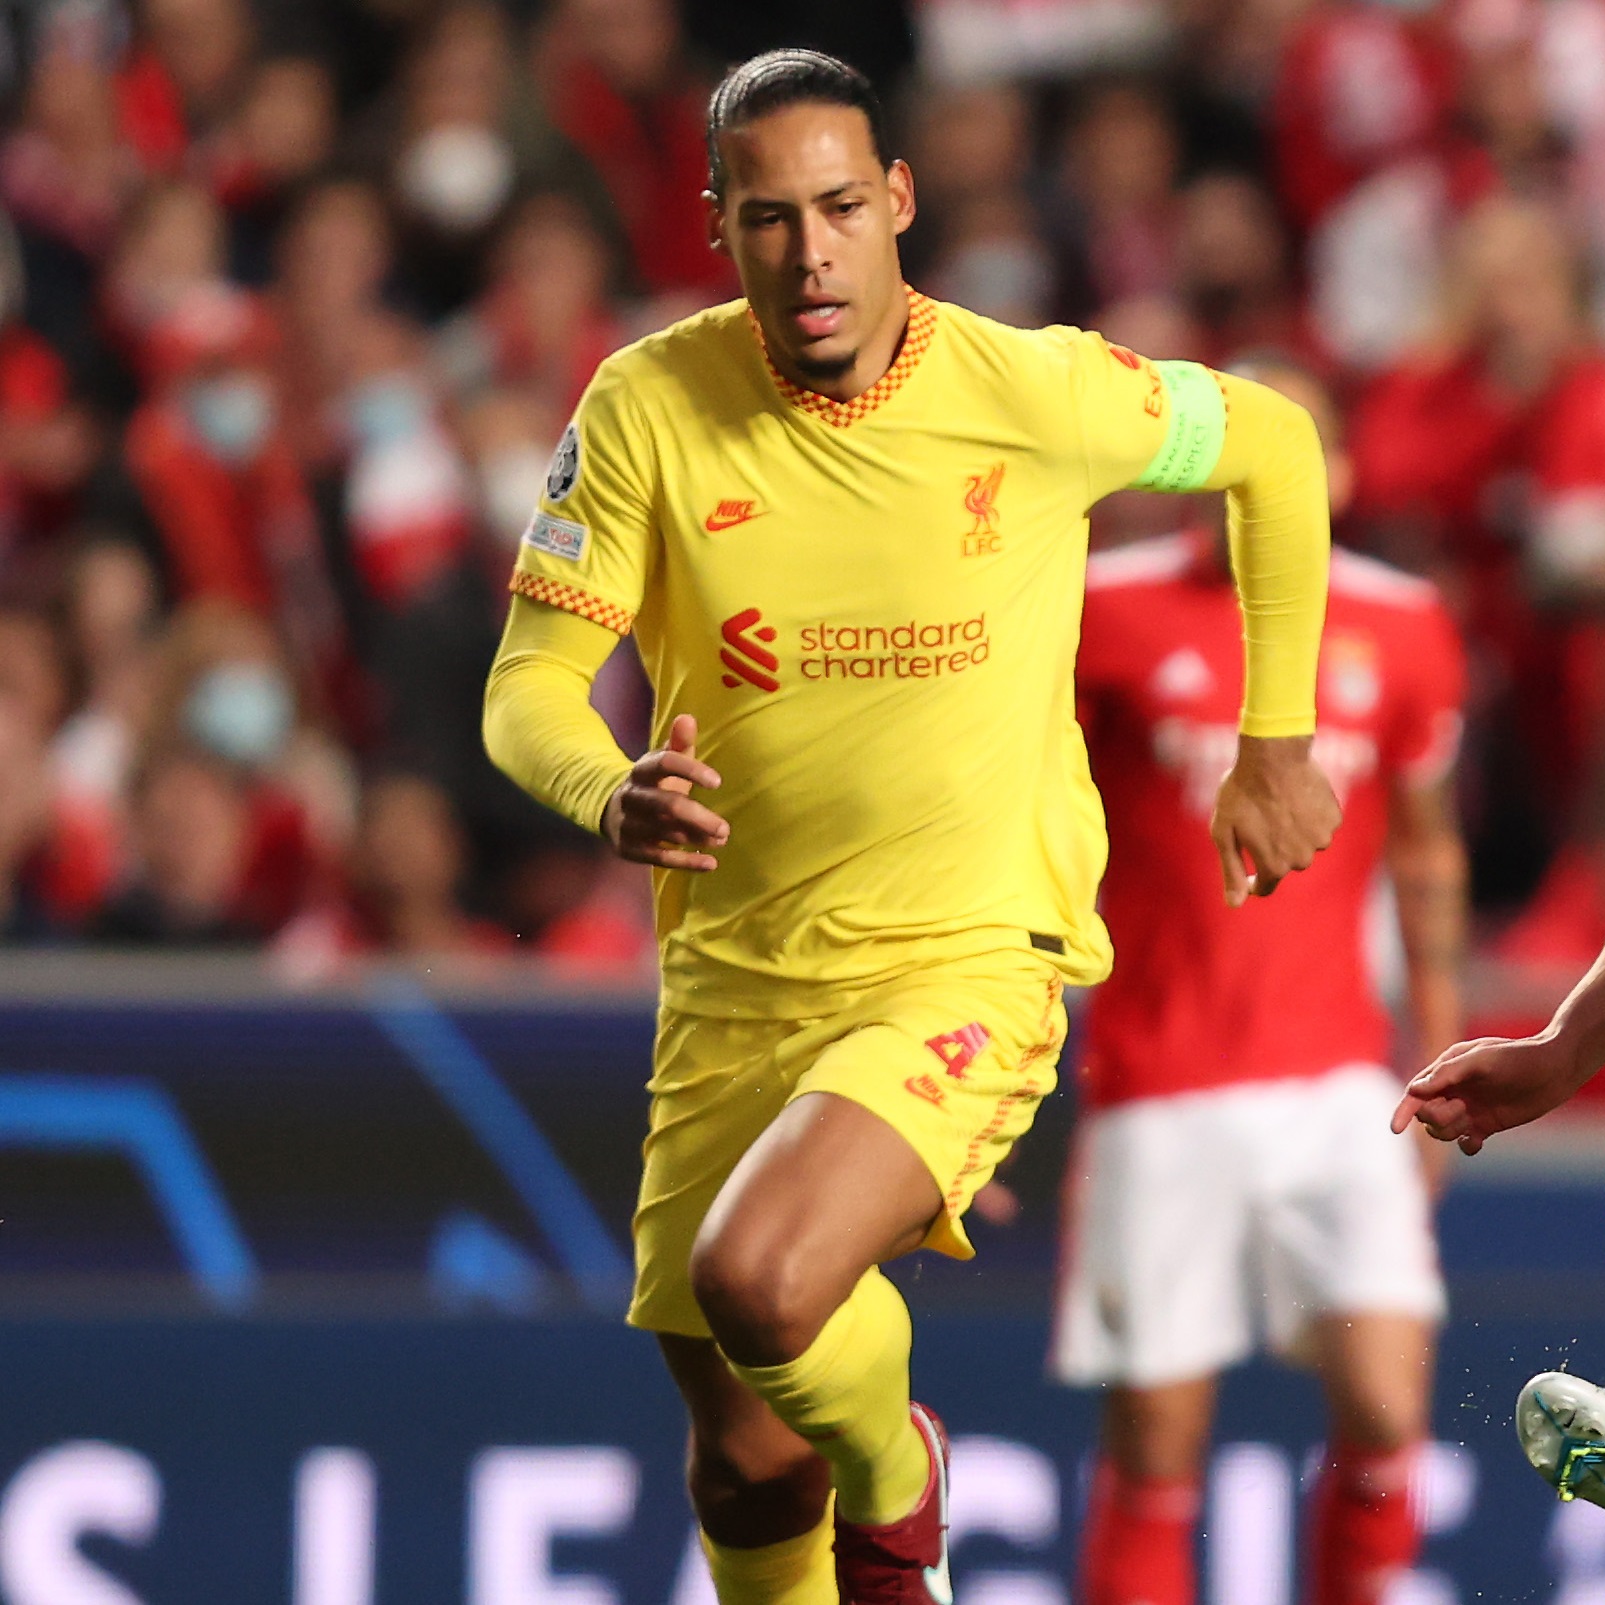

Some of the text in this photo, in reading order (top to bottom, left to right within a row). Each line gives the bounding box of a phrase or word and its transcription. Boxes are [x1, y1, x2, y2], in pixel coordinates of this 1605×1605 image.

[715, 499, 756, 519] NIKE
[800, 612, 986, 652] standard
[800, 636, 990, 681] chartered
[924, 1021, 991, 1079] 4
